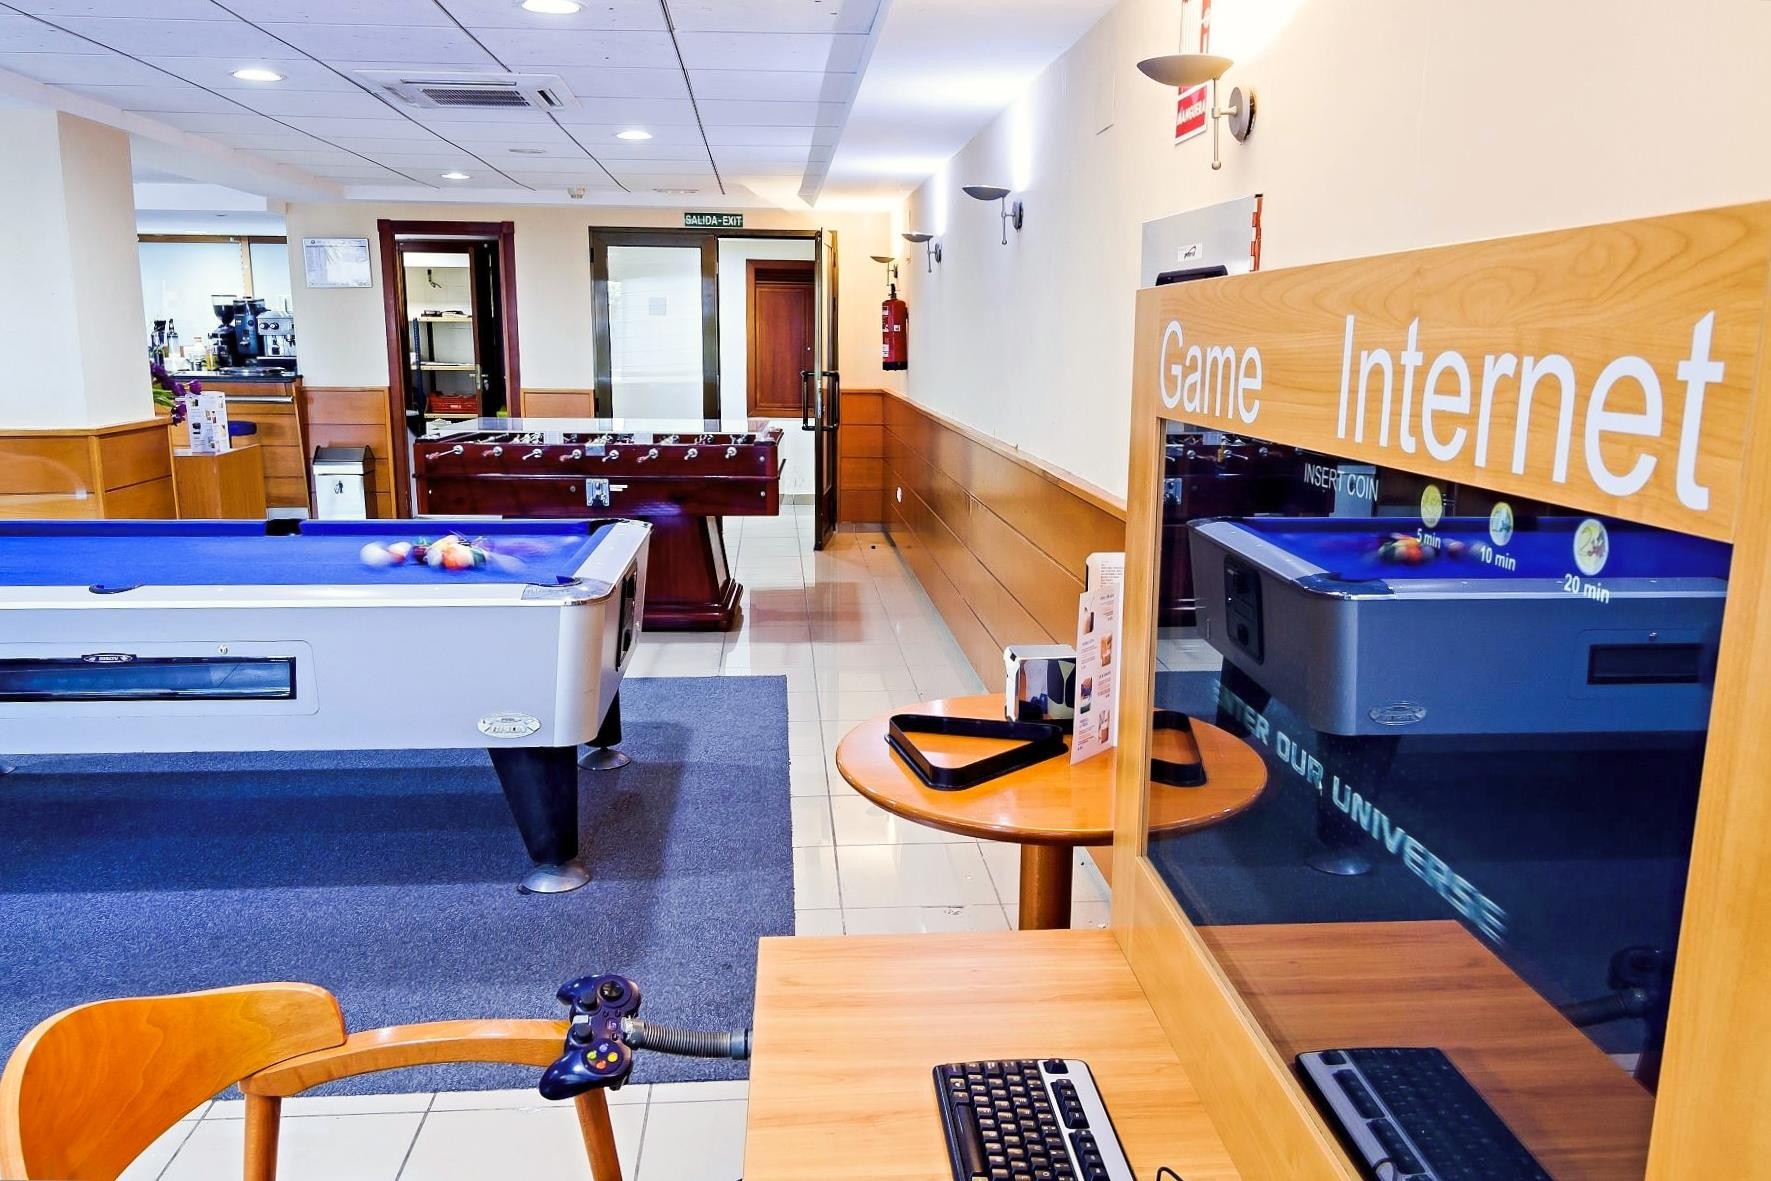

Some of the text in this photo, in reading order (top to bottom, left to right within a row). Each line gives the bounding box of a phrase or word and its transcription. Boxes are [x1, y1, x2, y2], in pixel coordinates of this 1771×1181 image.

[685, 215, 742, 226] SALIDA-EXIT
[1160, 310, 1725, 511] Game Internet
[1304, 462, 1379, 502] INSERT COIN
[1416, 528, 1441, 549] 5 min
[1480, 544, 1516, 571] 10 min
[1563, 573, 1610, 604] 20 min
[1276, 730, 1324, 790] OUR
